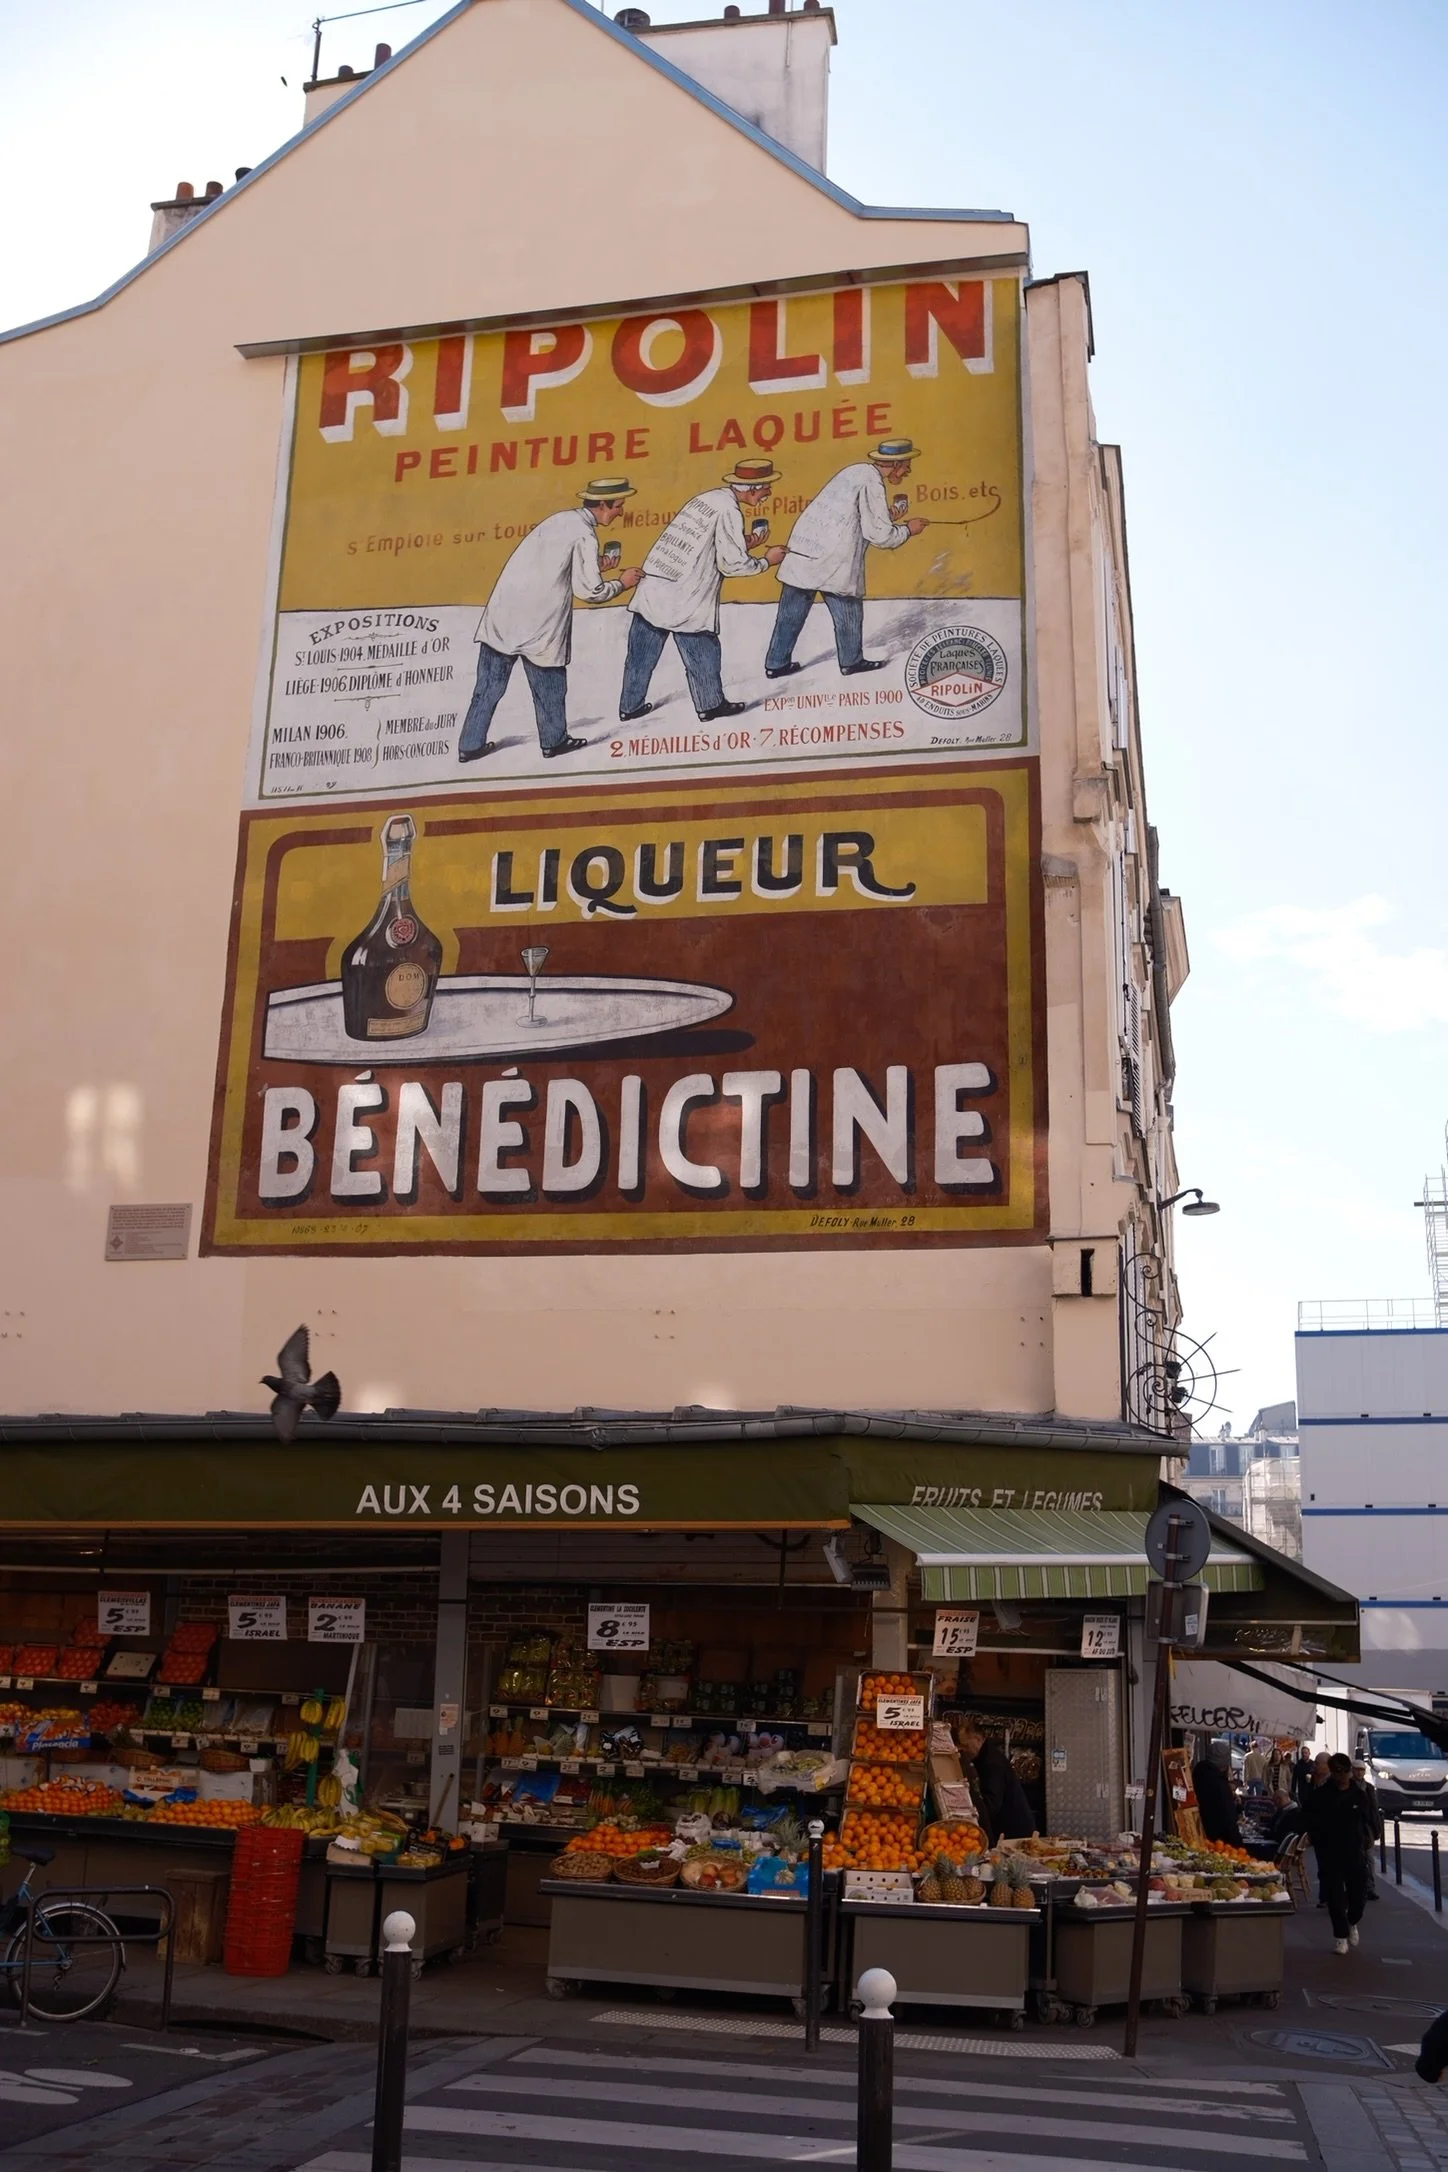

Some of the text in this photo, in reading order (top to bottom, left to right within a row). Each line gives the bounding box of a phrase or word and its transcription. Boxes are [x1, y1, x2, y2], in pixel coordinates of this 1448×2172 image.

[319, 279, 995, 444] RIPOLIN
[394, 400, 894, 483] PEINTURE LAQUÉE
[452, 530, 486, 544] sur
[622, 509, 677, 529] Métau
[744, 502, 770, 517] sur
[309, 613, 440, 645] EXPOSITIONS
[920, 640, 933, 652] DE
[939, 648, 977, 660] Laques
[395, 665, 454, 688] d'HONNEUR
[838, 691, 871, 708] PARIS
[875, 689, 904, 705] 1900
[385, 716, 425, 735] MEMBRE
[434, 712, 458, 730] JURY
[271, 725, 312, 744] MILAN
[628, 731, 710, 757] MÉDAILLES
[779, 720, 905, 747] RÉCOMPENSES
[353, 747, 373, 764] 1908
[489, 831, 917, 919] LIQUEUR
[258, 1062, 1000, 1202] BÉNÉDICTINE
[900, 1215, 916, 1227] 28
[355, 1484, 641, 1515] AUX 4 SAISONS
[910, 1486, 983, 1508] FRUITS
[105, 1607, 125, 1624] 5
[237, 1612, 257, 1628] 5
[314, 1613, 338, 1631] 2
[113, 1625, 147, 1633] ESP
[323, 1632, 360, 1640] MARTINIQUE
[596, 1620, 620, 1638] 8
[942, 1627, 959, 1645] 15
[606, 1639, 645, 1647] ESP
[1089, 1630, 1104, 1647] 12
[946, 1646, 973, 1654] ESP
[884, 1706, 901, 1719] 5
